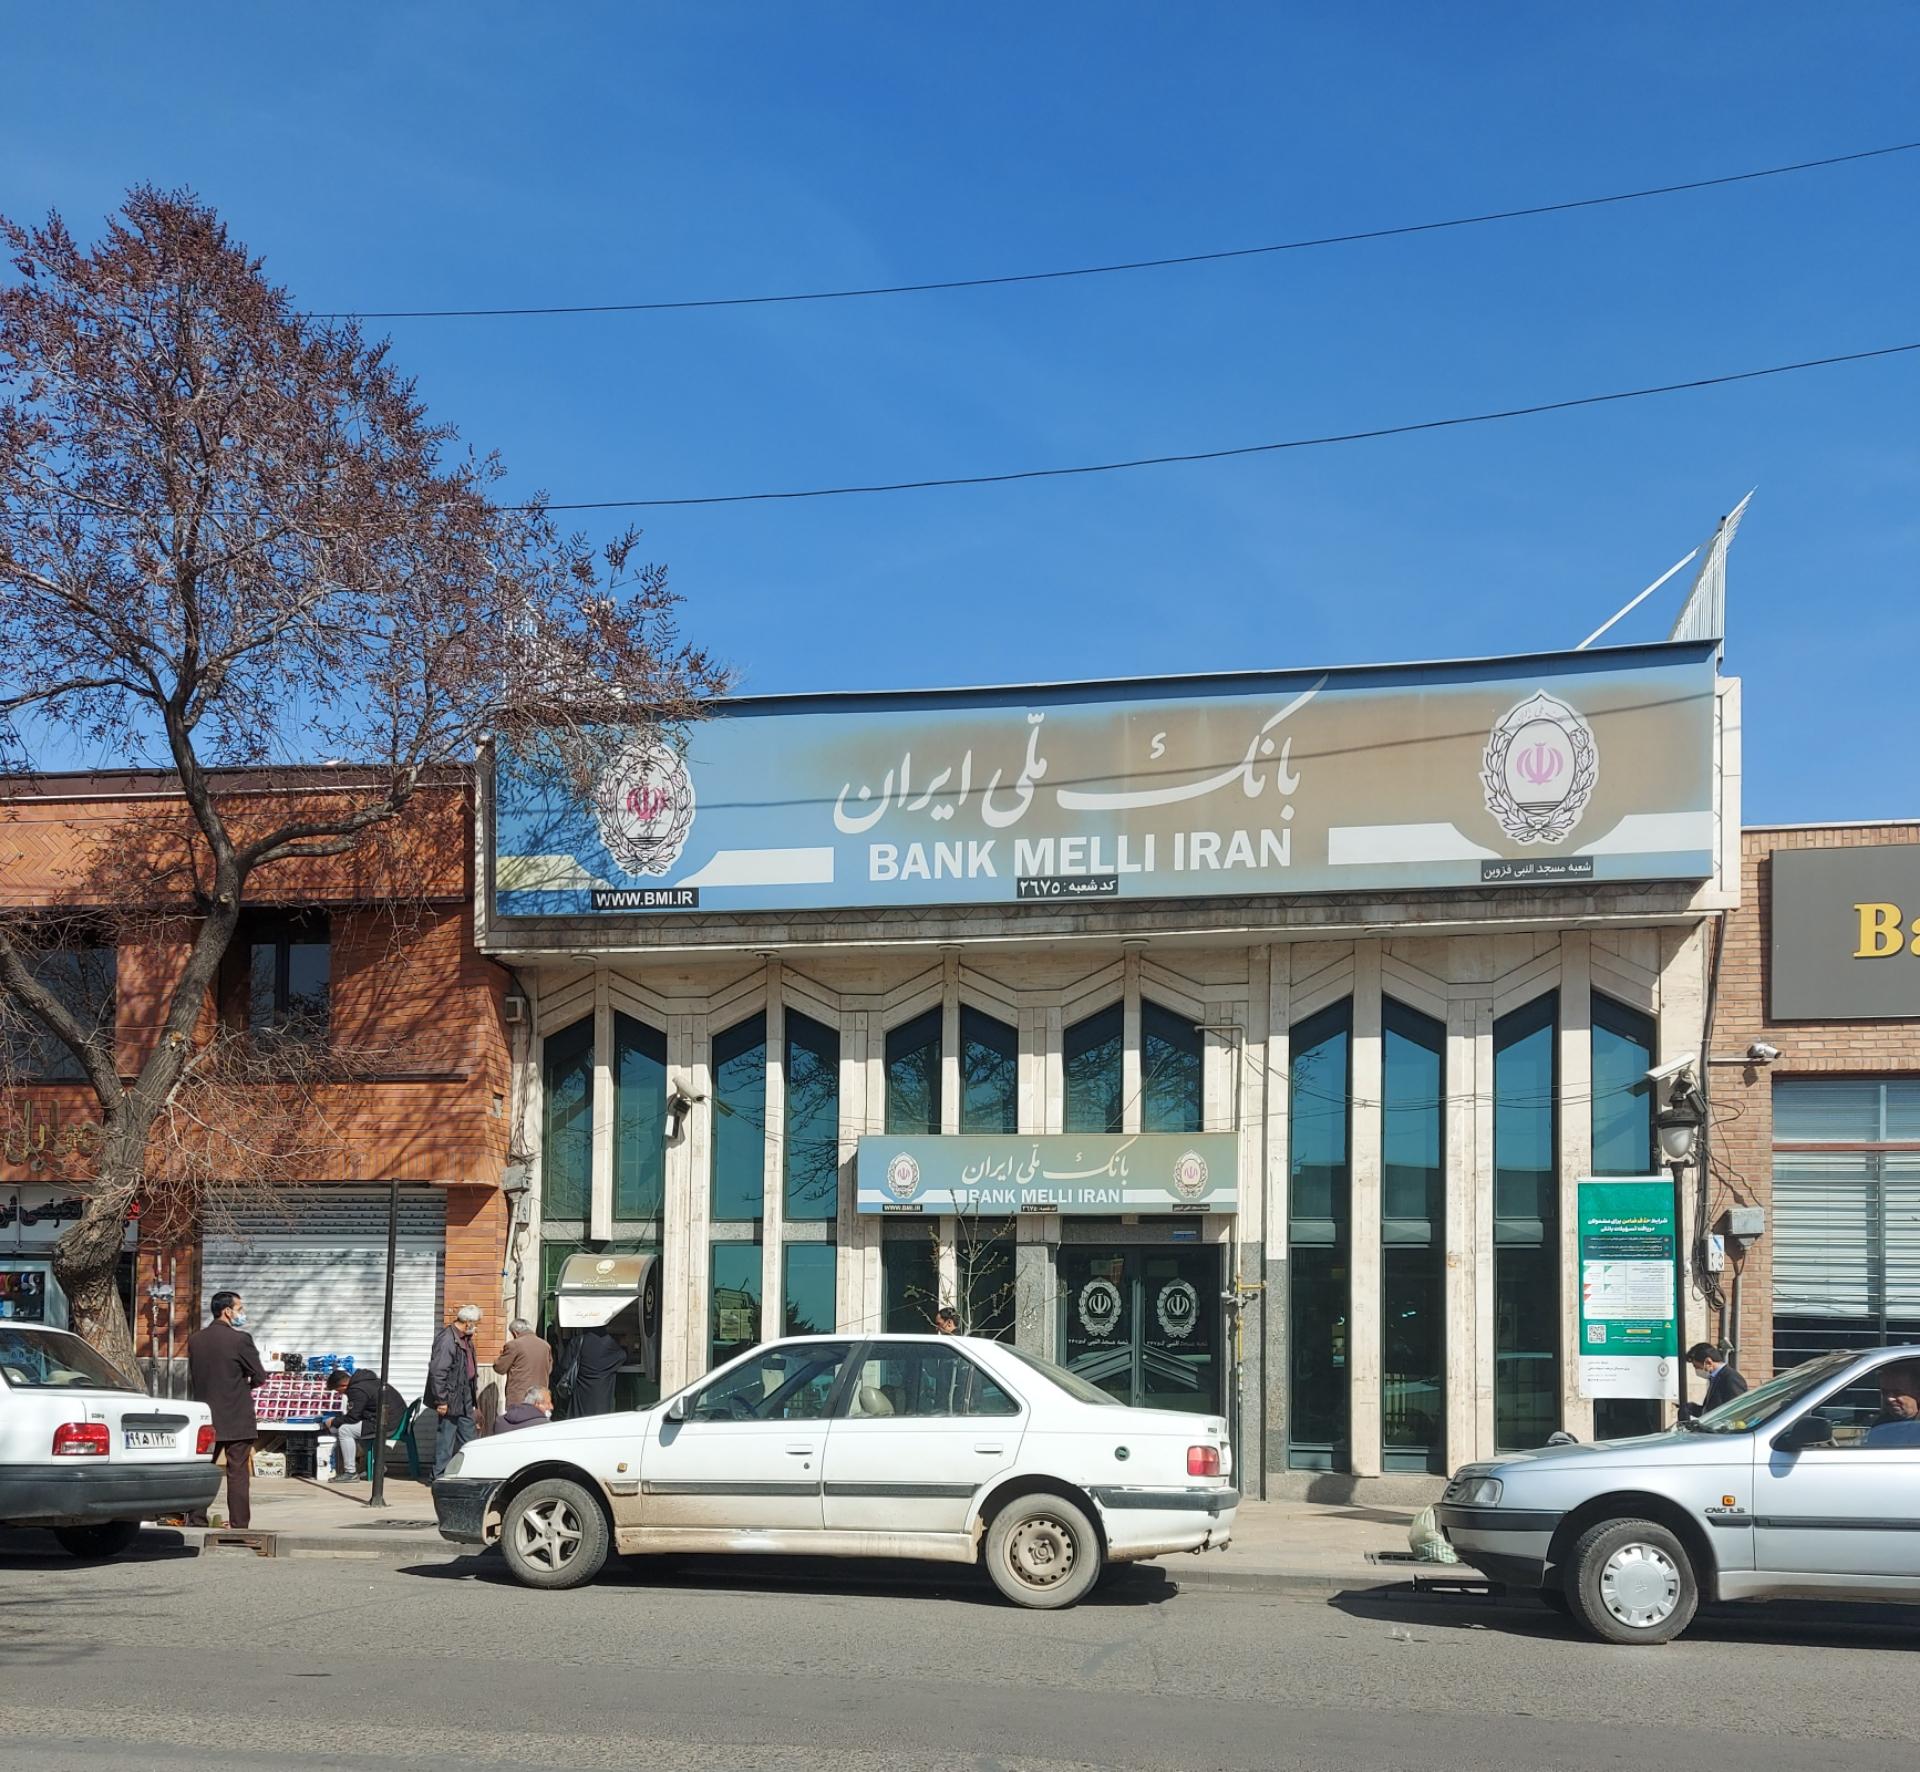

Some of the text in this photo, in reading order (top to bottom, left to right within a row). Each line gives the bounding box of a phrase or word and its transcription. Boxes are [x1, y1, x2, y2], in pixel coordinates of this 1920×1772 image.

[833, 749, 972, 834] ایران
[869, 828, 1291, 882] BANK MELLI IRAN
[1483, 865, 1512, 879] قزوین
[1536, 864, 1566, 876] مسجد
[1568, 861, 1592, 874] شعبه
[1099, 880, 1116, 891] کد
[596, 890, 694, 907] WWW.BMI.IR
[1852, 901, 1920, 958] B
[961, 1155, 1013, 1185] ایران
[968, 1189, 1120, 1204] BANK MELLI IRAN
